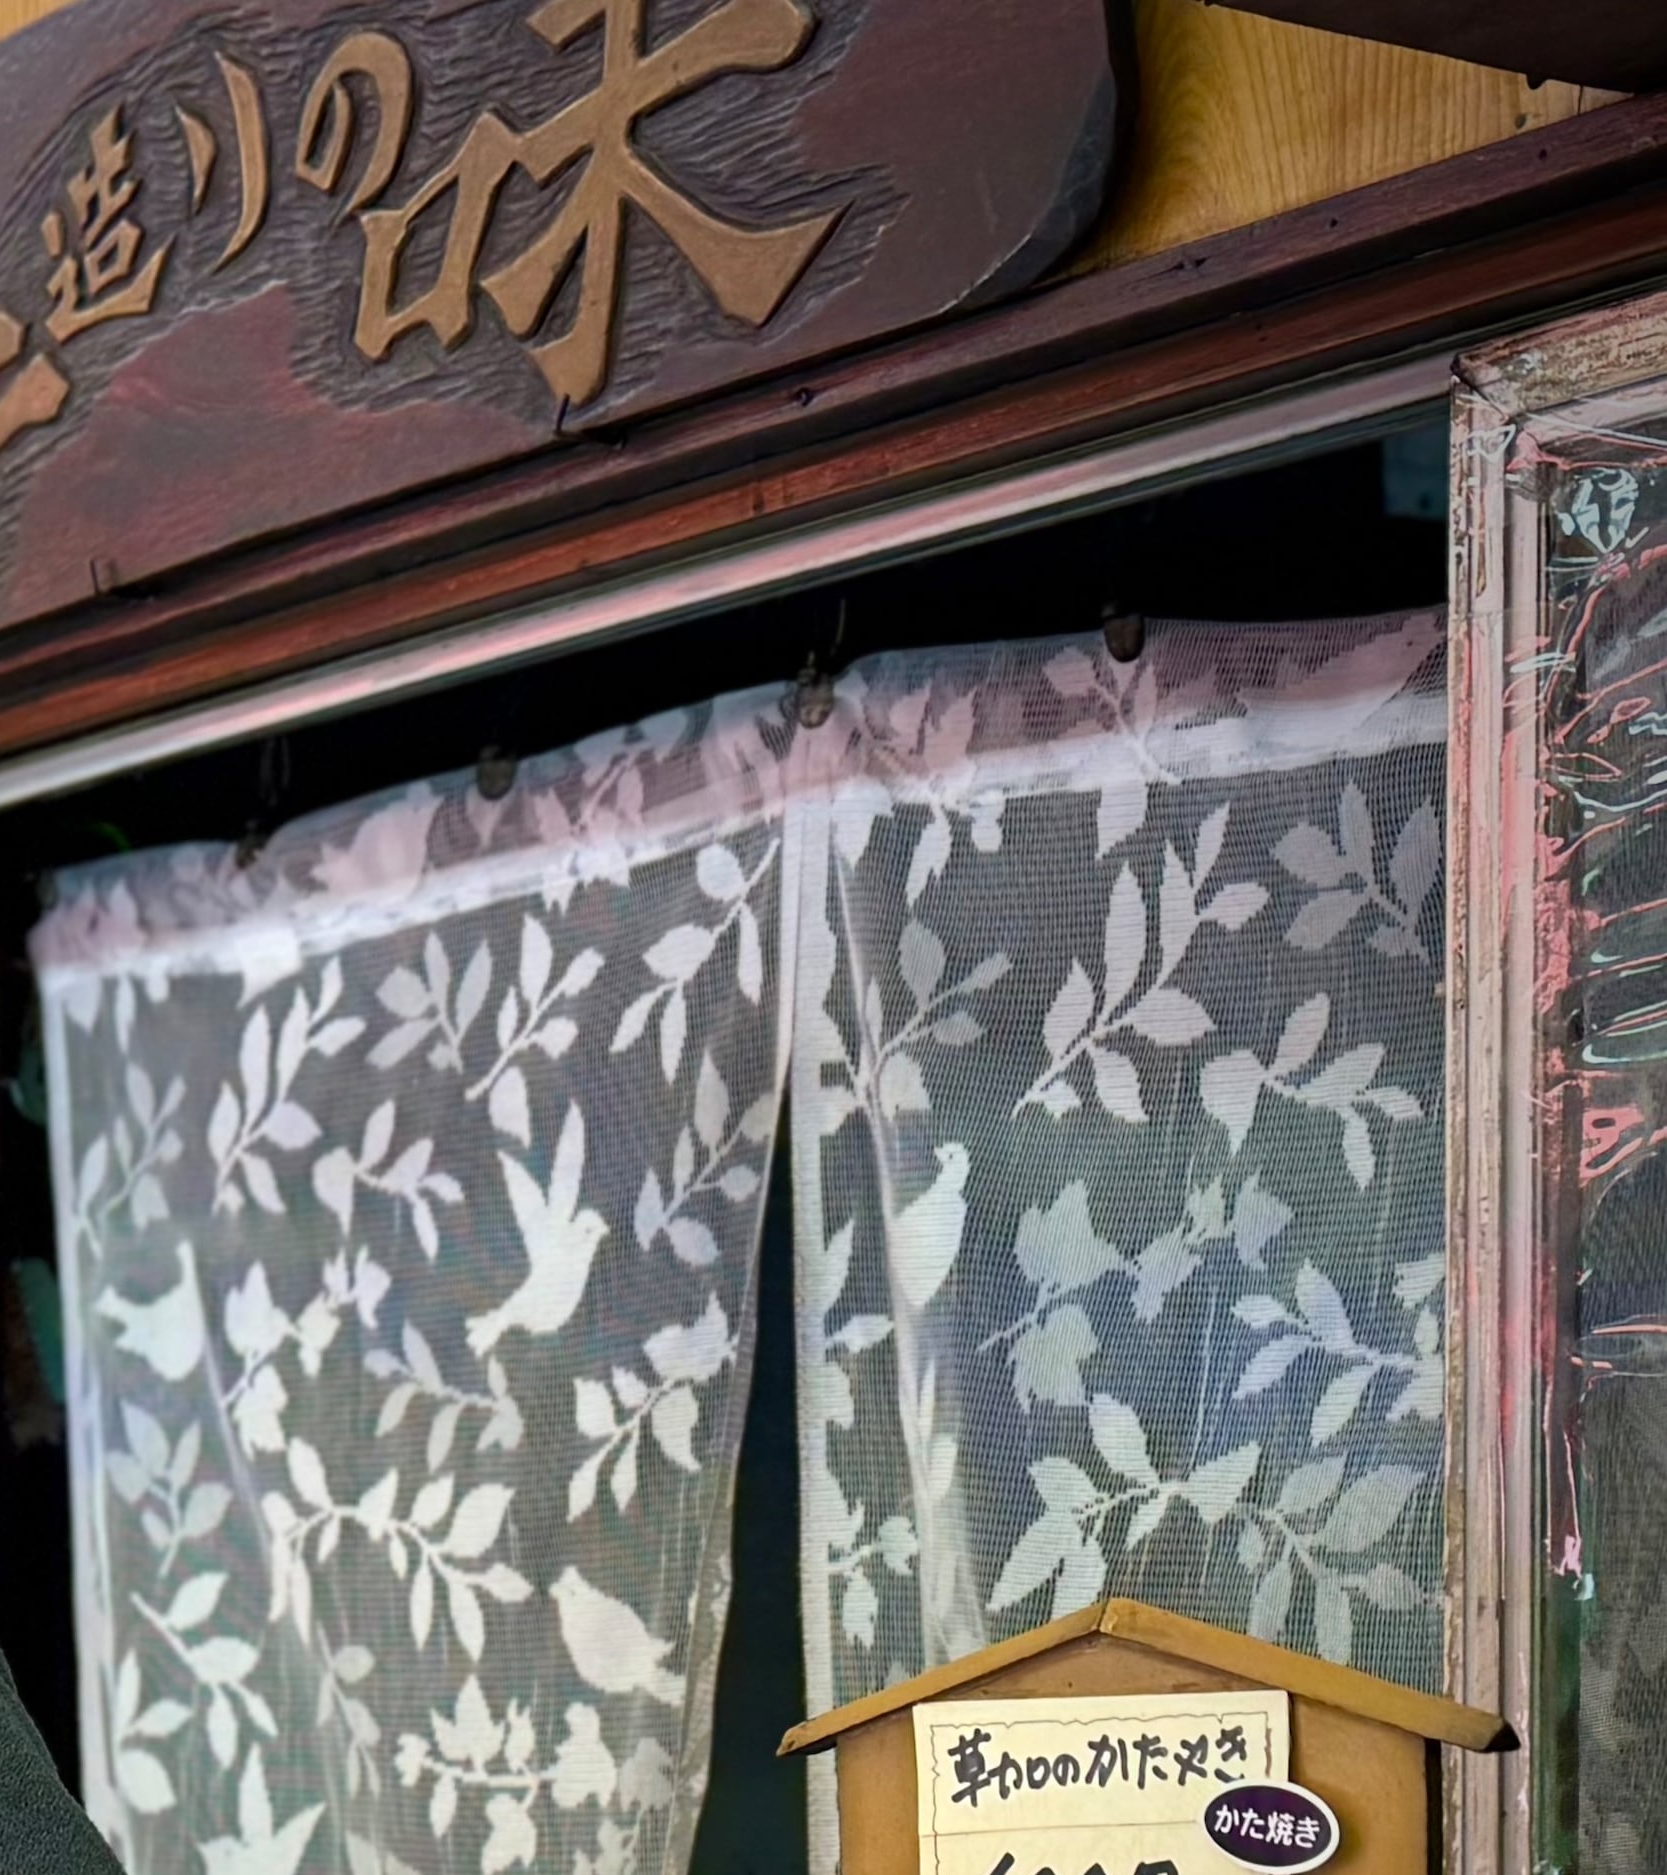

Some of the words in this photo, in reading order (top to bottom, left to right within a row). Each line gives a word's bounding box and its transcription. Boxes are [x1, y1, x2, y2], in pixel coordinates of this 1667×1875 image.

[947, 1726, 1248, 1807] 草加のかたやき
[1215, 1803, 1321, 1849] かた焼き
